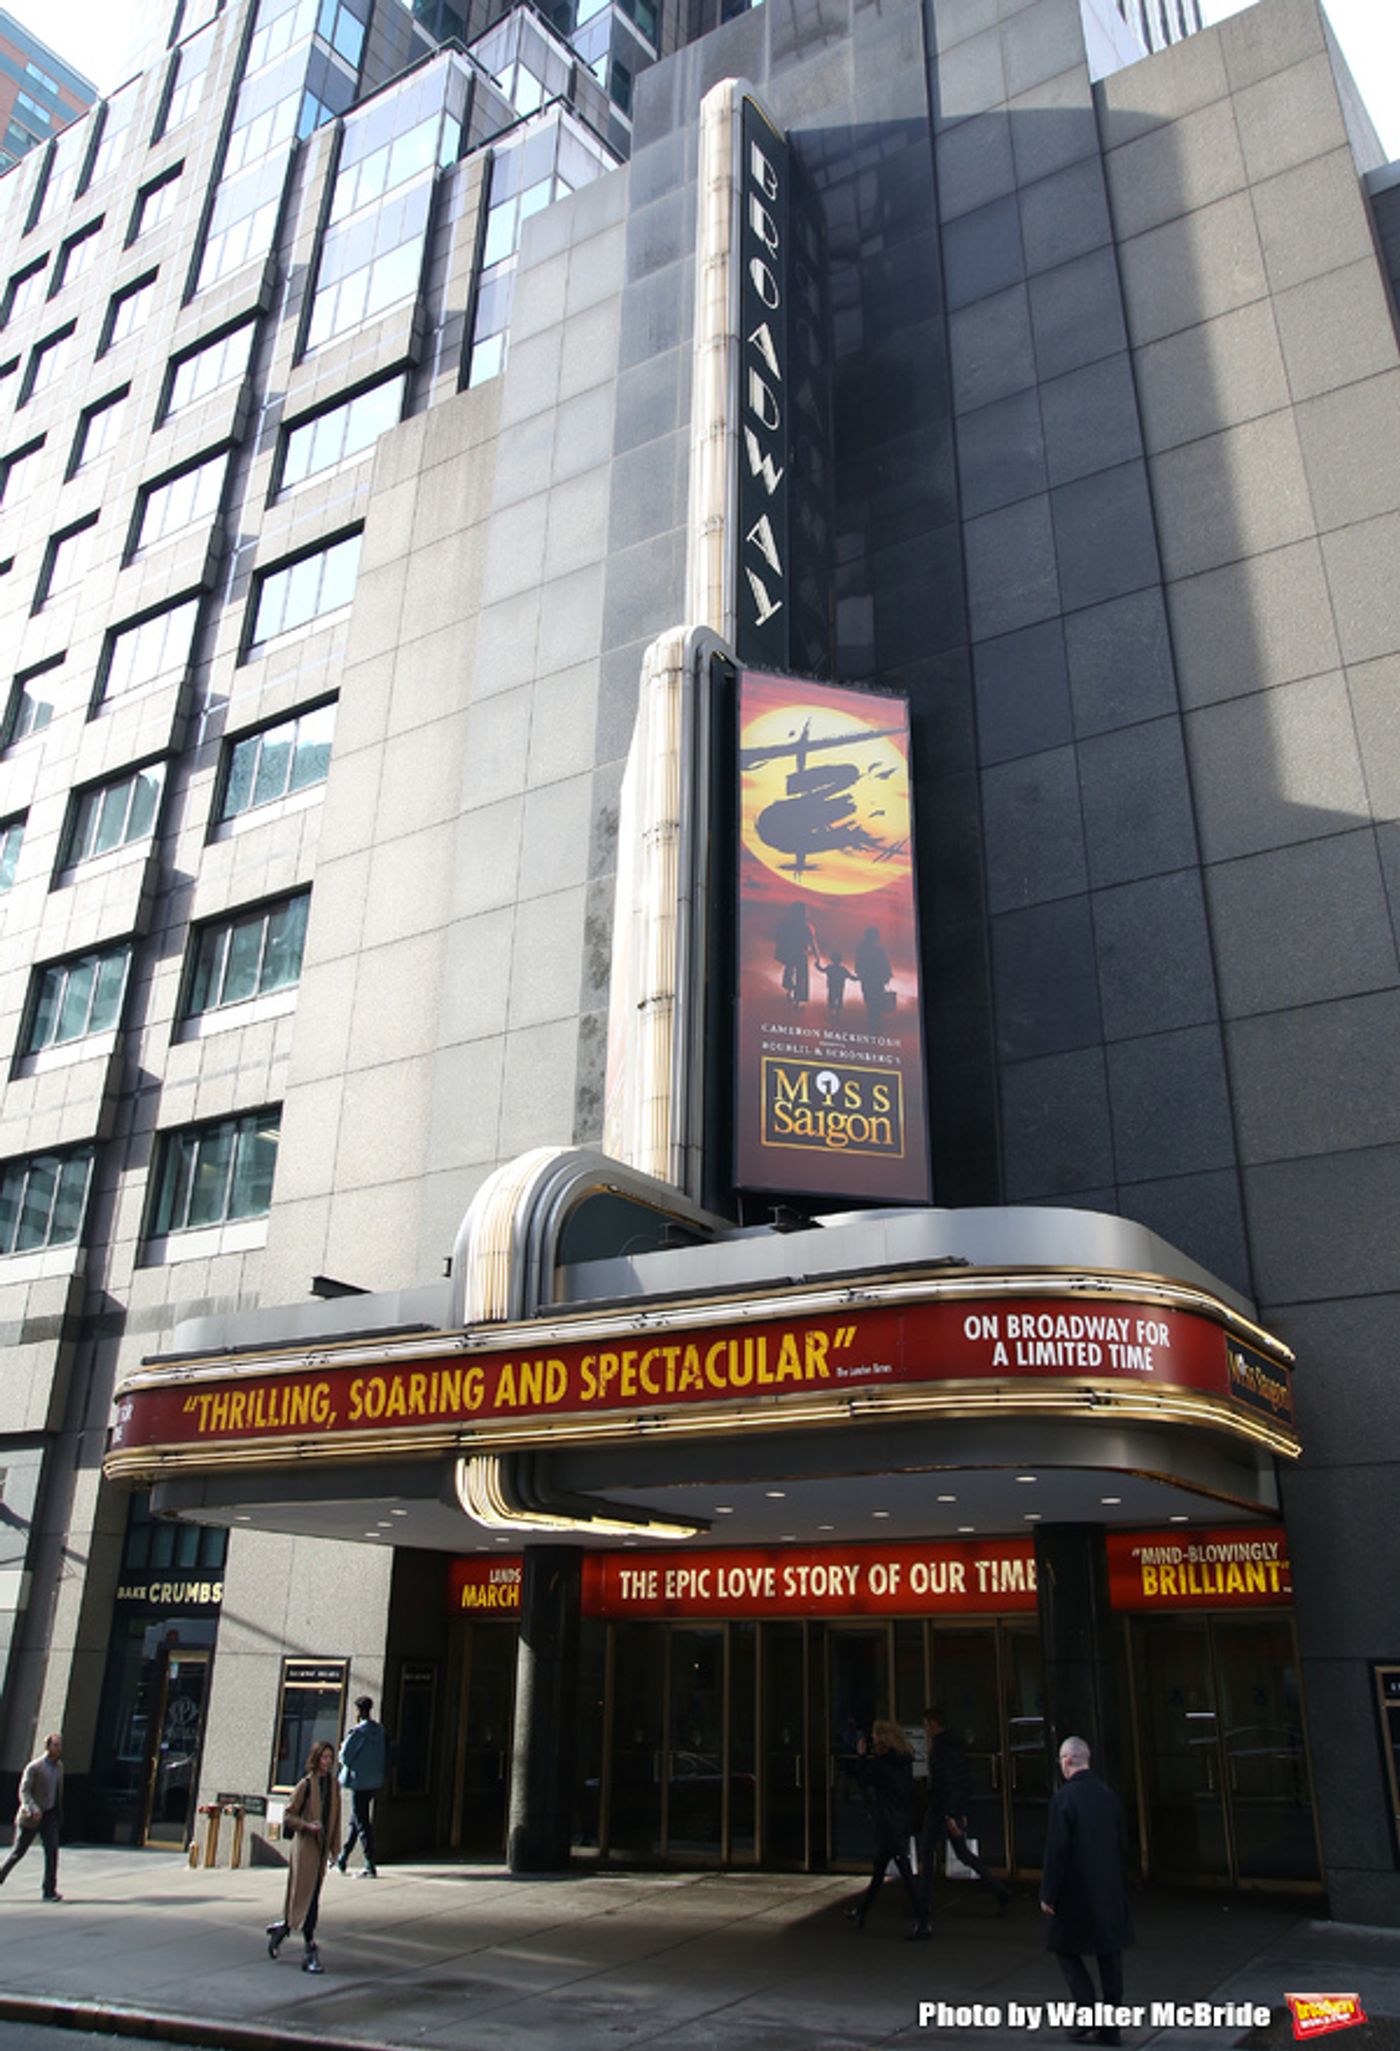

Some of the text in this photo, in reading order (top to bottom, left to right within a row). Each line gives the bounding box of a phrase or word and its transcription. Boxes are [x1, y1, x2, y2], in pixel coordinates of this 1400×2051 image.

[744, 140, 784, 627] BROADWAY
[761, 1023, 821, 1039] CAMERON
[773, 1100, 894, 1148] Saigon
[964, 1313, 1171, 1348] ON BROADWAY FOR
[992, 1341, 1155, 1372] A LIMITED TIME
[183, 1382, 337, 1432] "THRILLING,
[348, 1366, 485, 1421] SOARING
[493, 1359, 569, 1408] AND
[580, 1325, 857, 1400] SPECTACULAR"
[489, 1567, 522, 1583] LANDS
[620, 1569, 658, 1599] THE
[664, 1567, 711, 1599] EPIC
[717, 1566, 776, 1598] LOVE
[783, 1564, 859, 1597] STORY
[868, 1563, 901, 1595] OF
[909, 1561, 966, 1594] OUR
[148, 1581, 224, 1604] CRUMBS
[461, 1583, 520, 1608] MARCH
